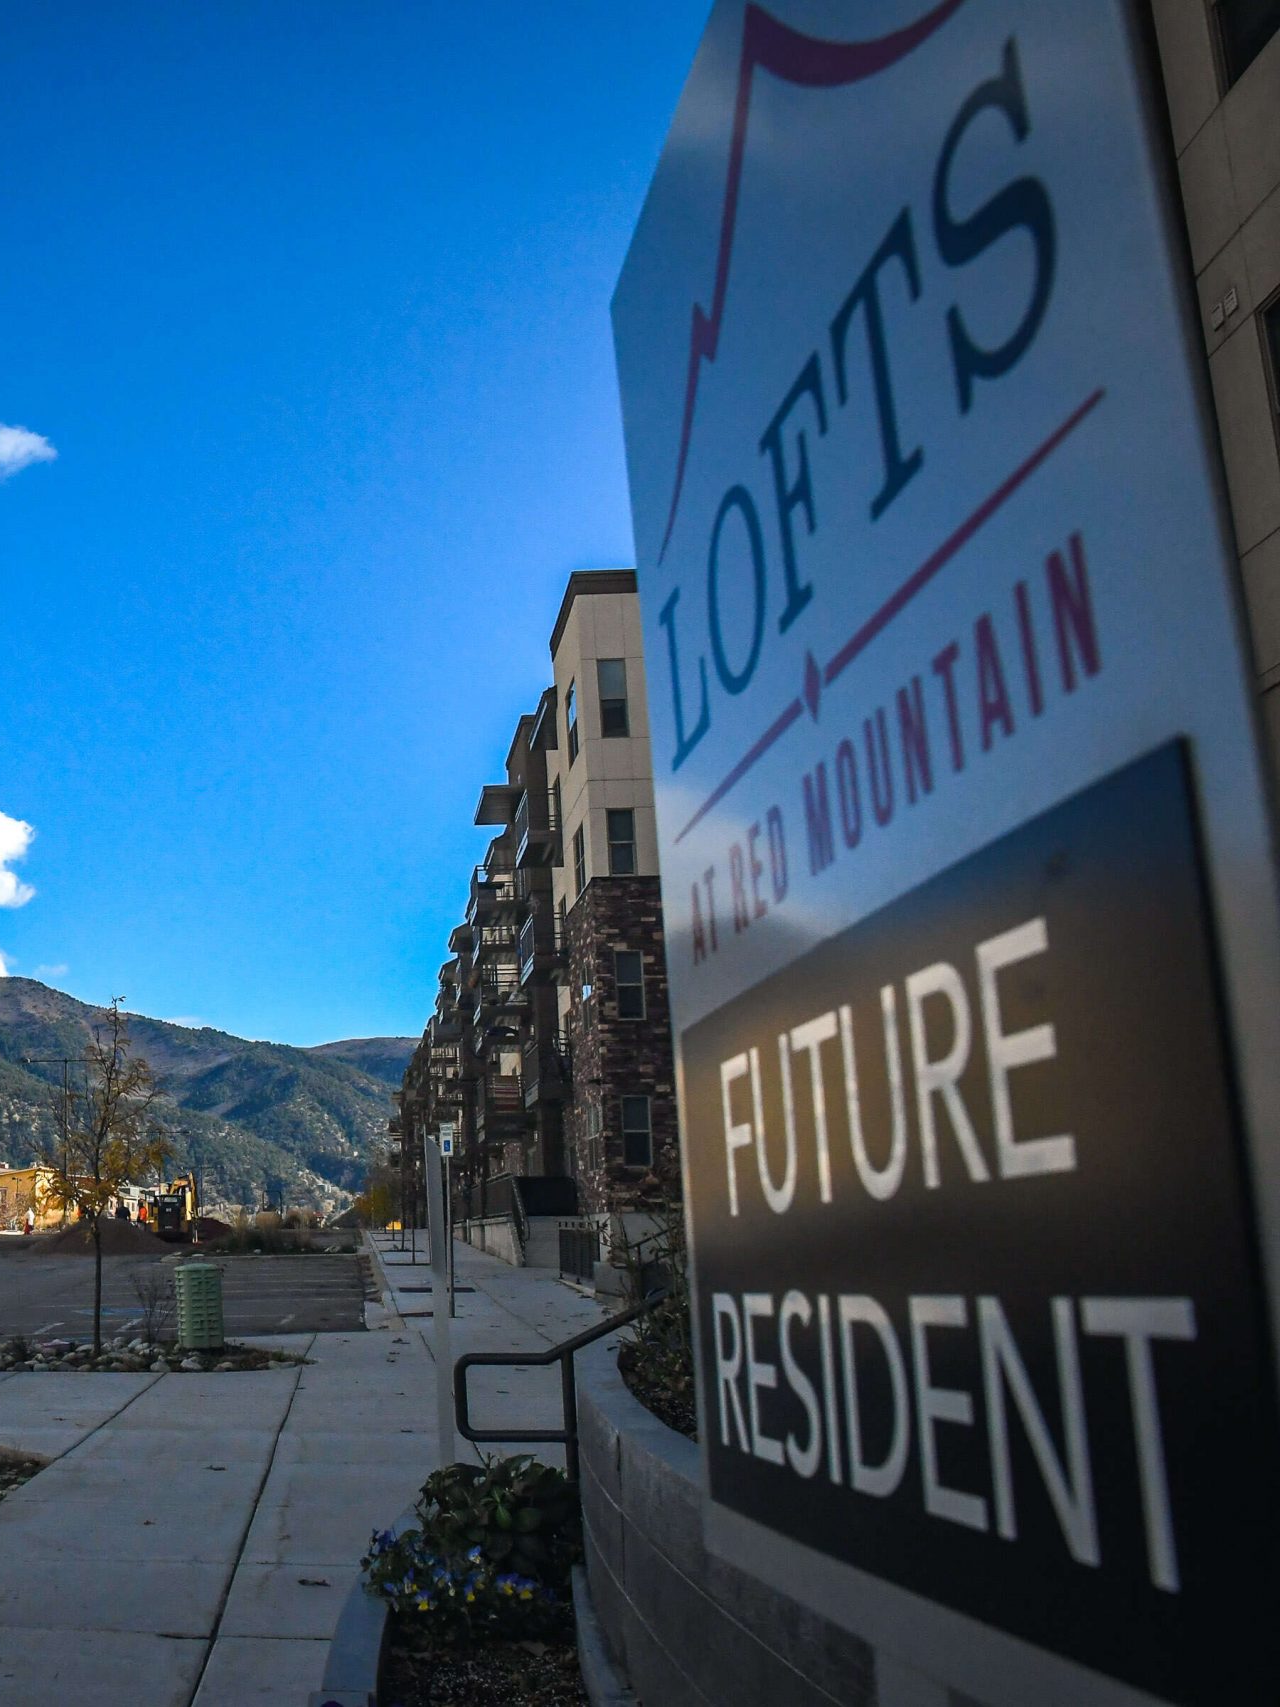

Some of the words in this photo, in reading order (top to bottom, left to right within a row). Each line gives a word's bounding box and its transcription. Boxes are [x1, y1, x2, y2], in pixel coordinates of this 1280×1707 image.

[659, 33, 1058, 773] LOFTS
[689, 863, 718, 966] AT
[729, 803, 790, 936] RED
[803, 530, 1102, 877] MOUNTAIN
[720, 917, 1077, 1217] FUTURE
[712, 1289, 1197, 1593] RESIDENT
